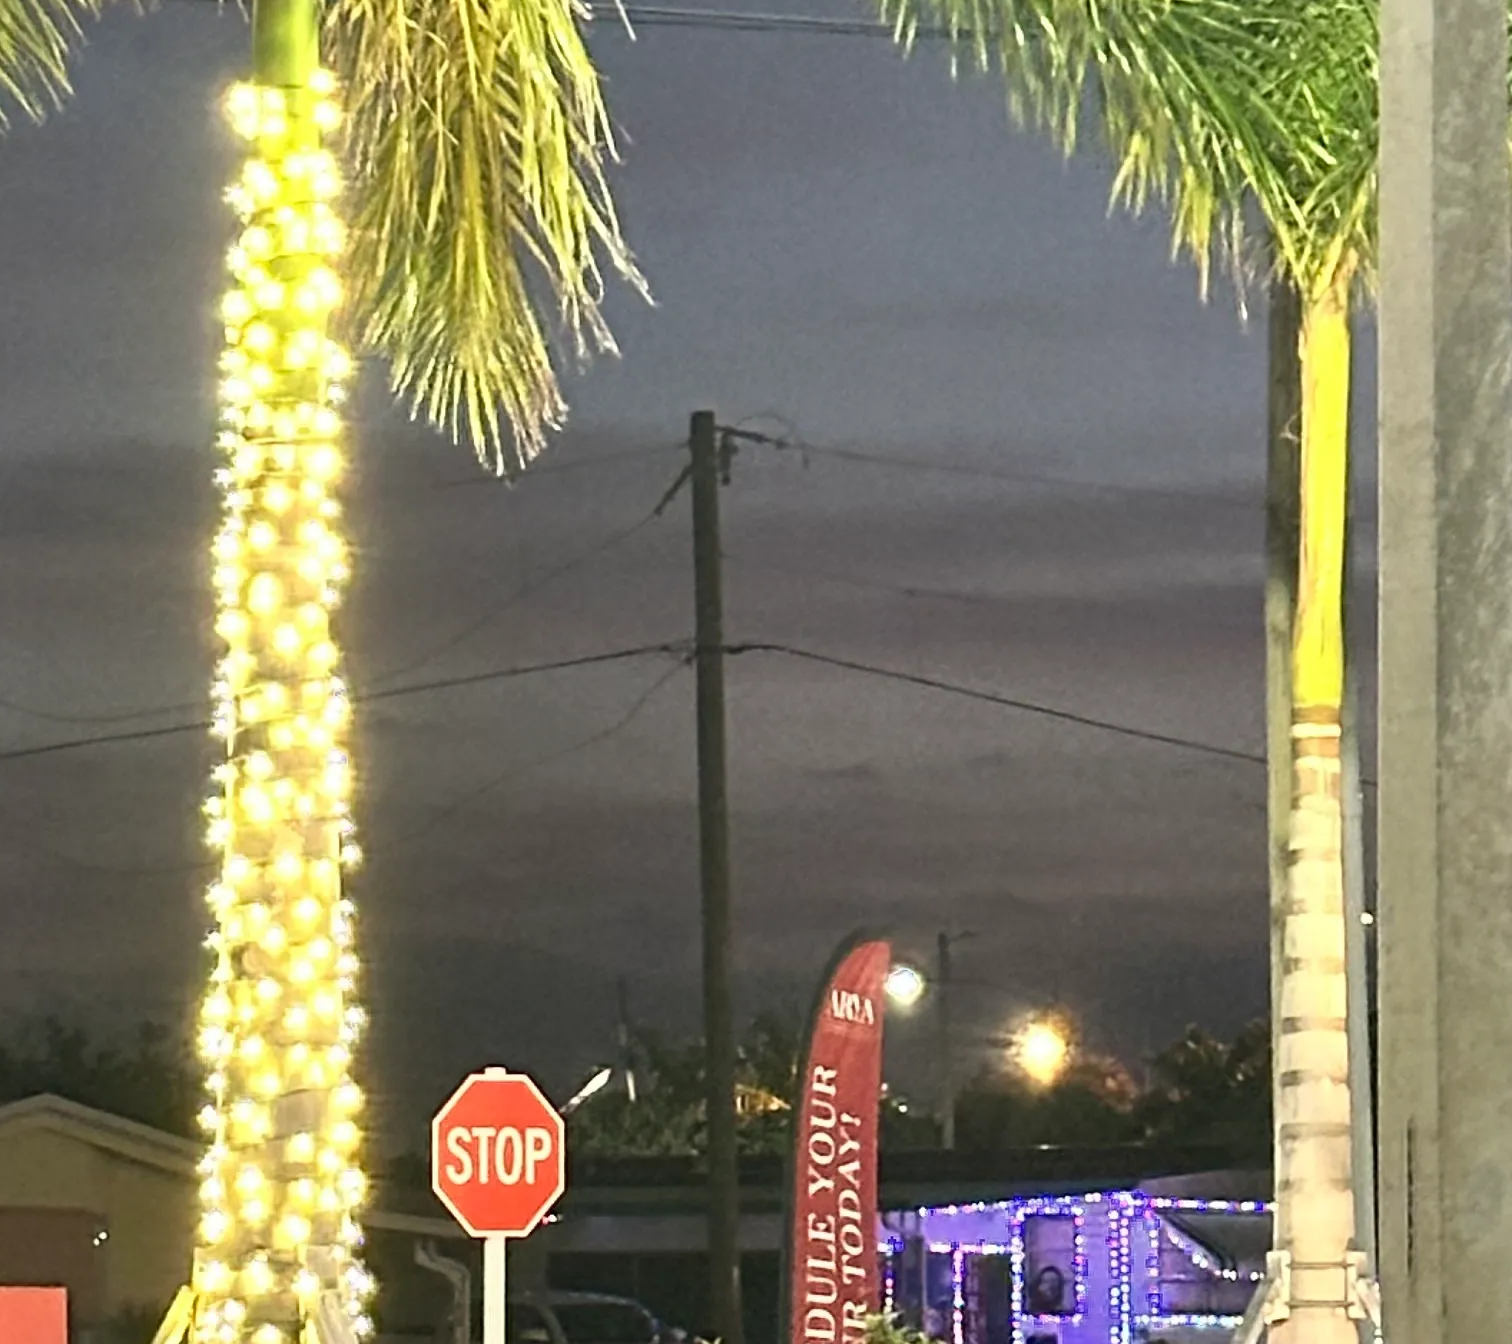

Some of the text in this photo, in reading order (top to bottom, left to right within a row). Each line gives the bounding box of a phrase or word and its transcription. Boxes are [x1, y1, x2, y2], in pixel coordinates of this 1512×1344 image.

[445, 1126, 553, 1185] STOP
[808, 1065, 838, 1200] YOUR
[838, 1112, 867, 1286] TODAY!
